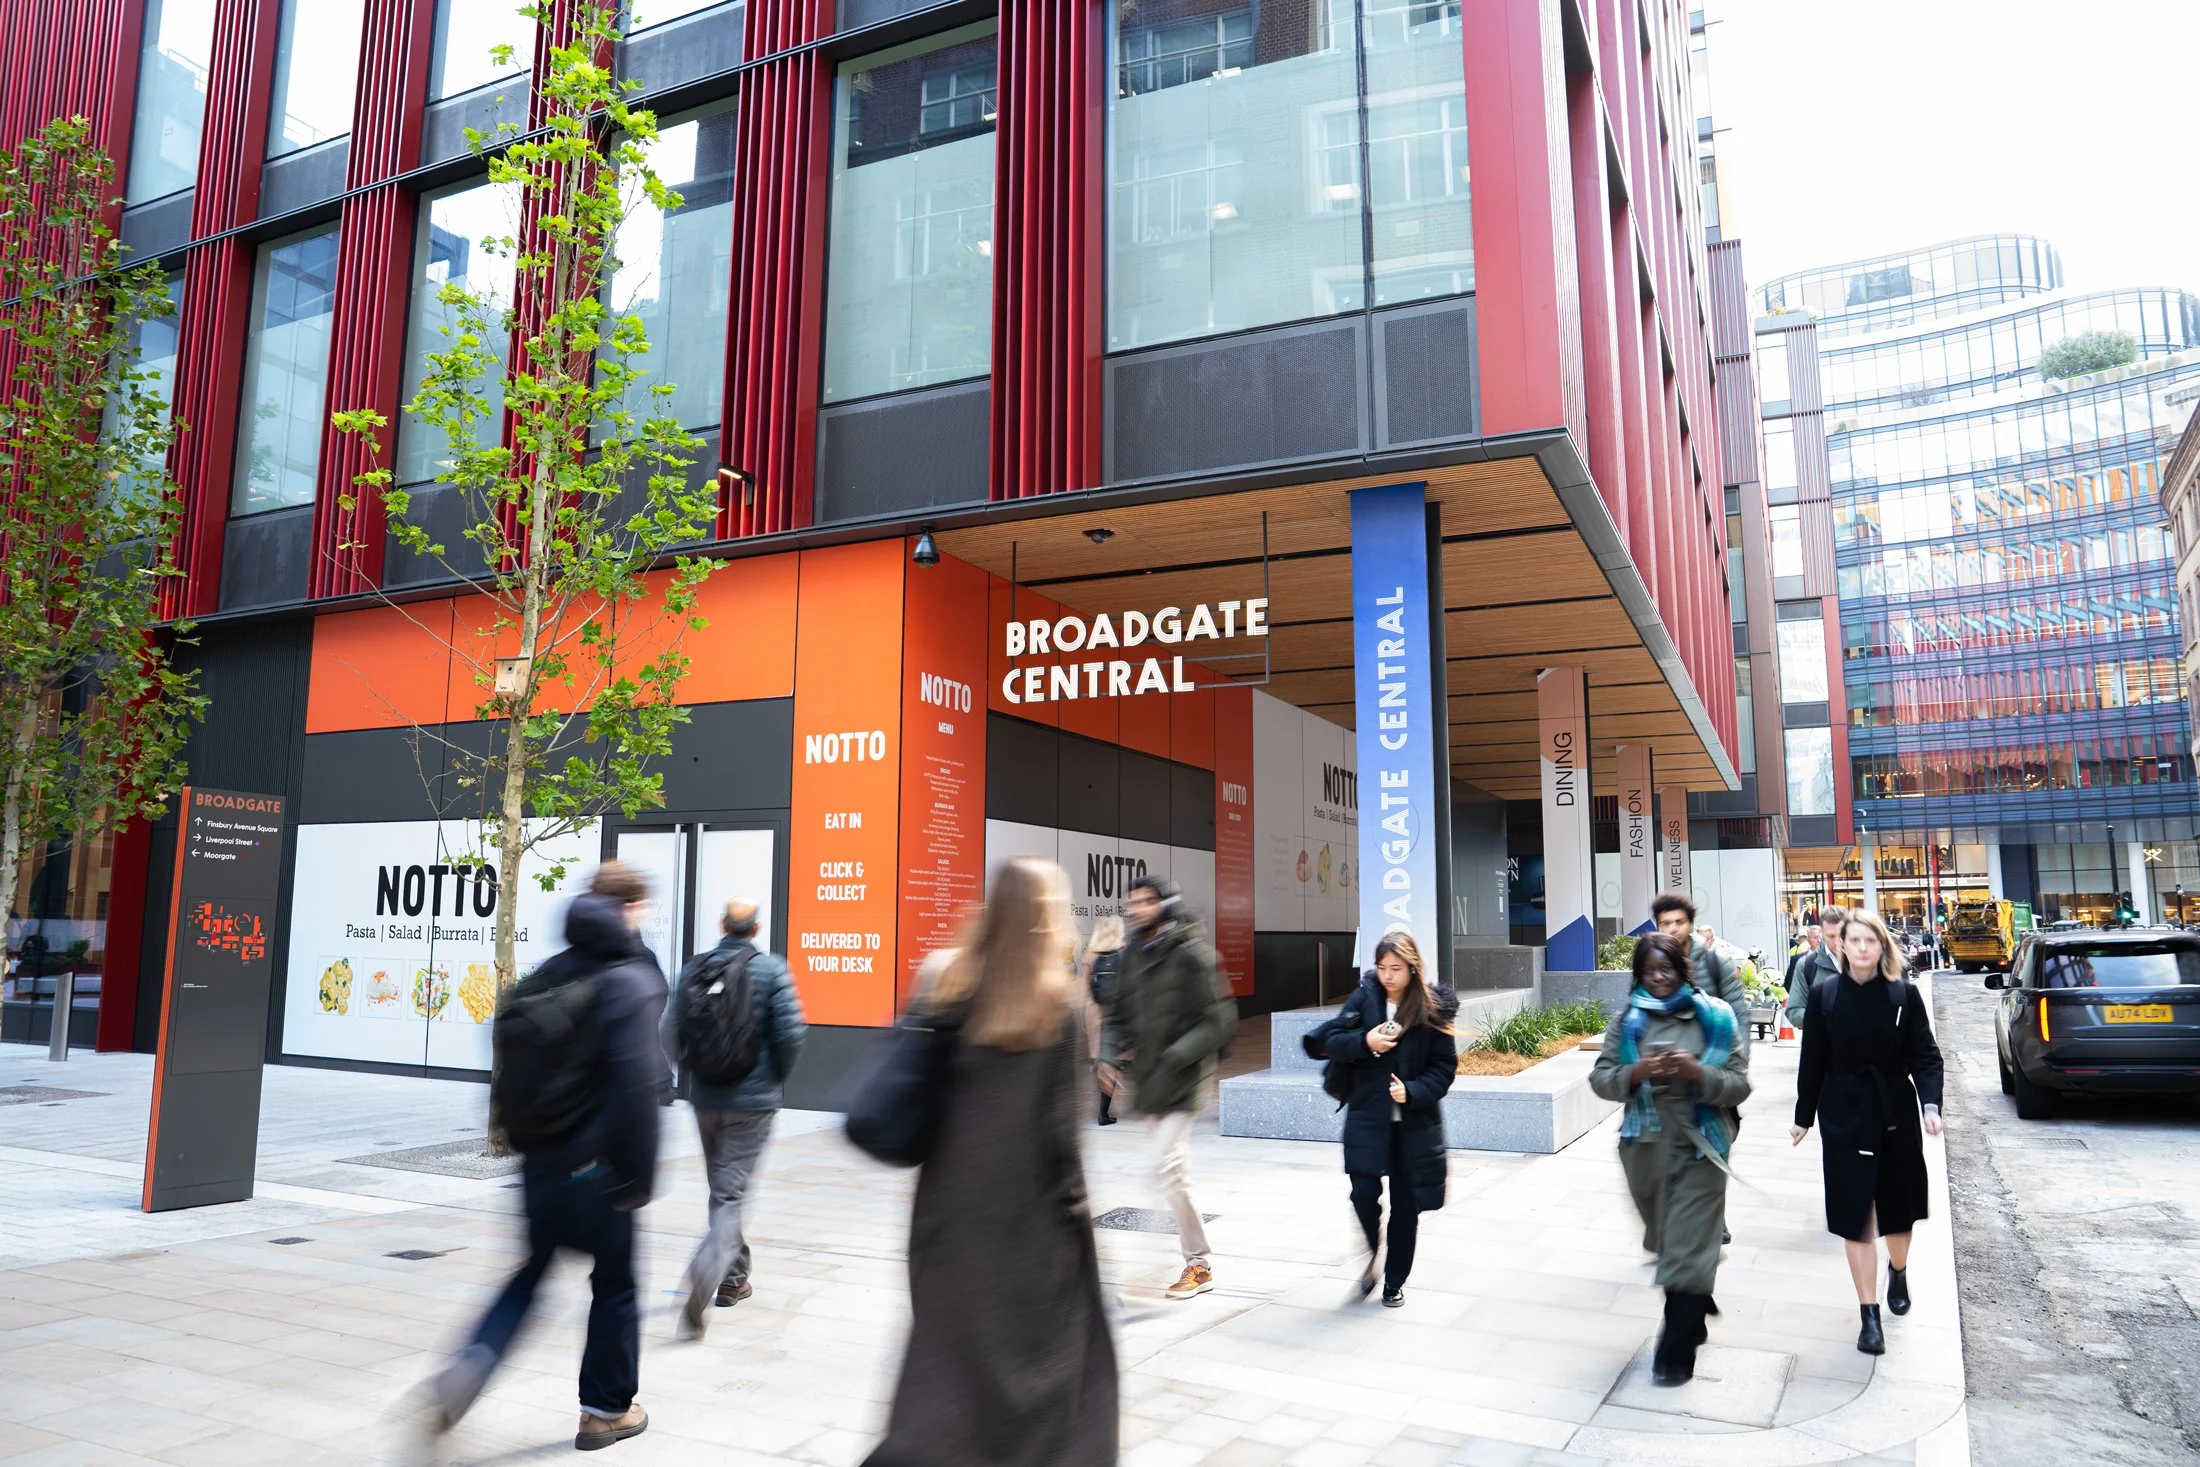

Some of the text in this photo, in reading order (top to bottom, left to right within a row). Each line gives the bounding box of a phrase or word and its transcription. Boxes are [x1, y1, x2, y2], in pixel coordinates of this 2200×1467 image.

[1006, 597, 1269, 657] BROADGATE
[1376, 586, 1409, 751] CENTRAL
[1002, 656, 1195, 704] CENTRAL
[920, 671, 972, 714] NOTTO
[938, 721, 954, 736] MENU
[805, 730, 886, 764] NOTTO
[1553, 731, 1575, 807] DINING
[1222, 781, 1247, 806] NOTTO
[195, 793, 281, 814] BROADGATE
[825, 812, 862, 830] EAT IN
[1313, 805, 1325, 819] Pasta
[1329, 809, 1340, 822] Salad
[207, 820, 279, 834] Finsbury Avenue Square
[1629, 789, 1644, 858] FASHION
[205, 836, 253, 847] Liverpool Street
[204, 851, 236, 861] Moorgate
[1669, 819, 1683, 888] WELLNESS
[820, 861, 864, 879] CLICK &
[376, 864, 498, 917] NOTTO
[816, 884, 866, 902] COLLECT
[1071, 904, 1088, 916] Pasta
[346, 924, 528, 942] Pasta Salad Burrata Bad
[801, 932, 881, 951] DELIVERED TO
[807, 955, 873, 974] YOUR DESK
